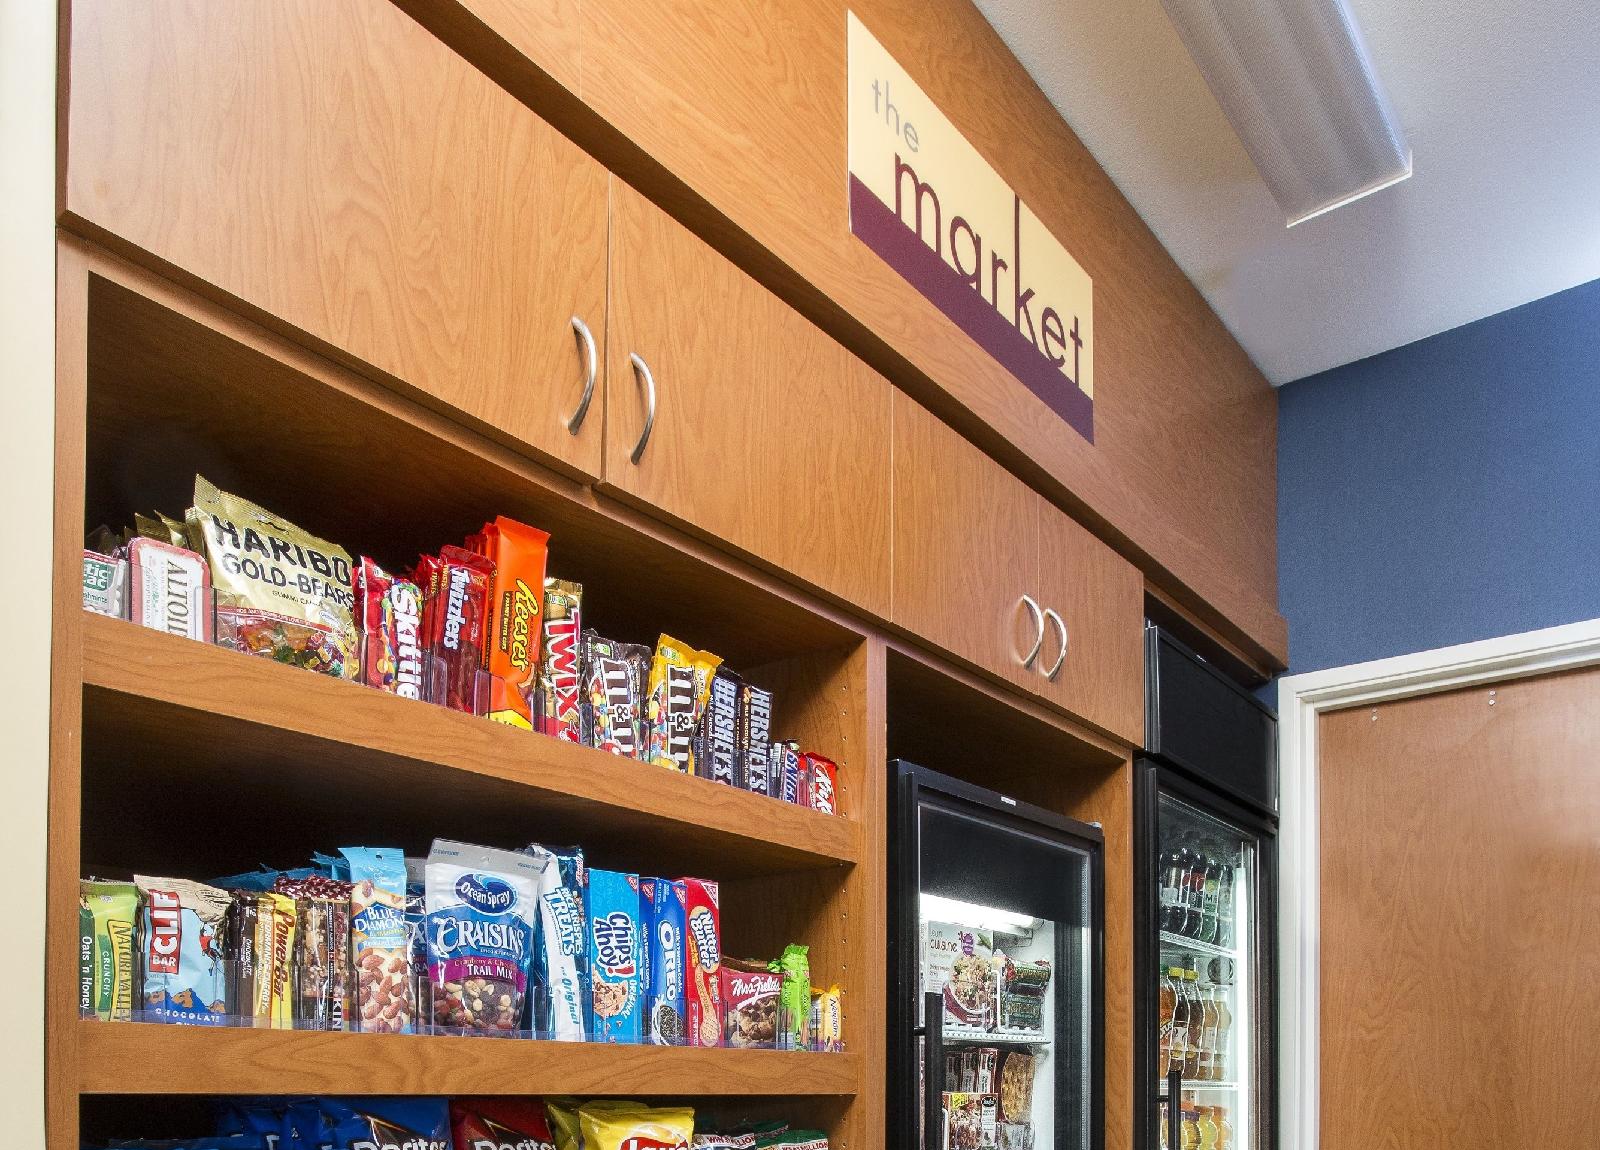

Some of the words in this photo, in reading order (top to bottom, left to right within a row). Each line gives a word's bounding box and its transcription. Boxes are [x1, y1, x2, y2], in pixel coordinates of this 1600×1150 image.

[872, 77, 919, 154] the
[894, 192, 1084, 385] market
[211, 514, 352, 588] HARIBO
[222, 552, 355, 614] GOLD-BEARS
[443, 567, 471, 651] Twizzlers
[391, 585, 422, 700] Skittle
[510, 578, 540, 672] Reese's
[545, 608, 581, 720] TWIX
[367, 906, 397, 920] BLUE
[460, 881, 488, 904] Ocean
[487, 890, 511, 909] Spray
[82, 936, 93, 961] Oats
[153, 892, 179, 955] CLIF
[354, 914, 406, 932] DIAMON
[432, 915, 525, 961] CRAISINS
[547, 888, 577, 957] TREATS
[608, 911, 632, 965] Chips
[690, 918, 711, 969] Butter
[701, 912, 720, 963] Nutter
[102, 950, 111, 997] CRUNCHY
[152, 955, 177, 968] BAR
[274, 910, 296, 999] PowerBar
[466, 964, 494, 976] TRAIL
[496, 966, 514, 980] MIX
[658, 920, 677, 1001] OREO
[79, 977, 93, 1010] Honey
[155, 1008, 221, 1023] CHOCOLATE
[332, 997, 342, 1031] KIN
